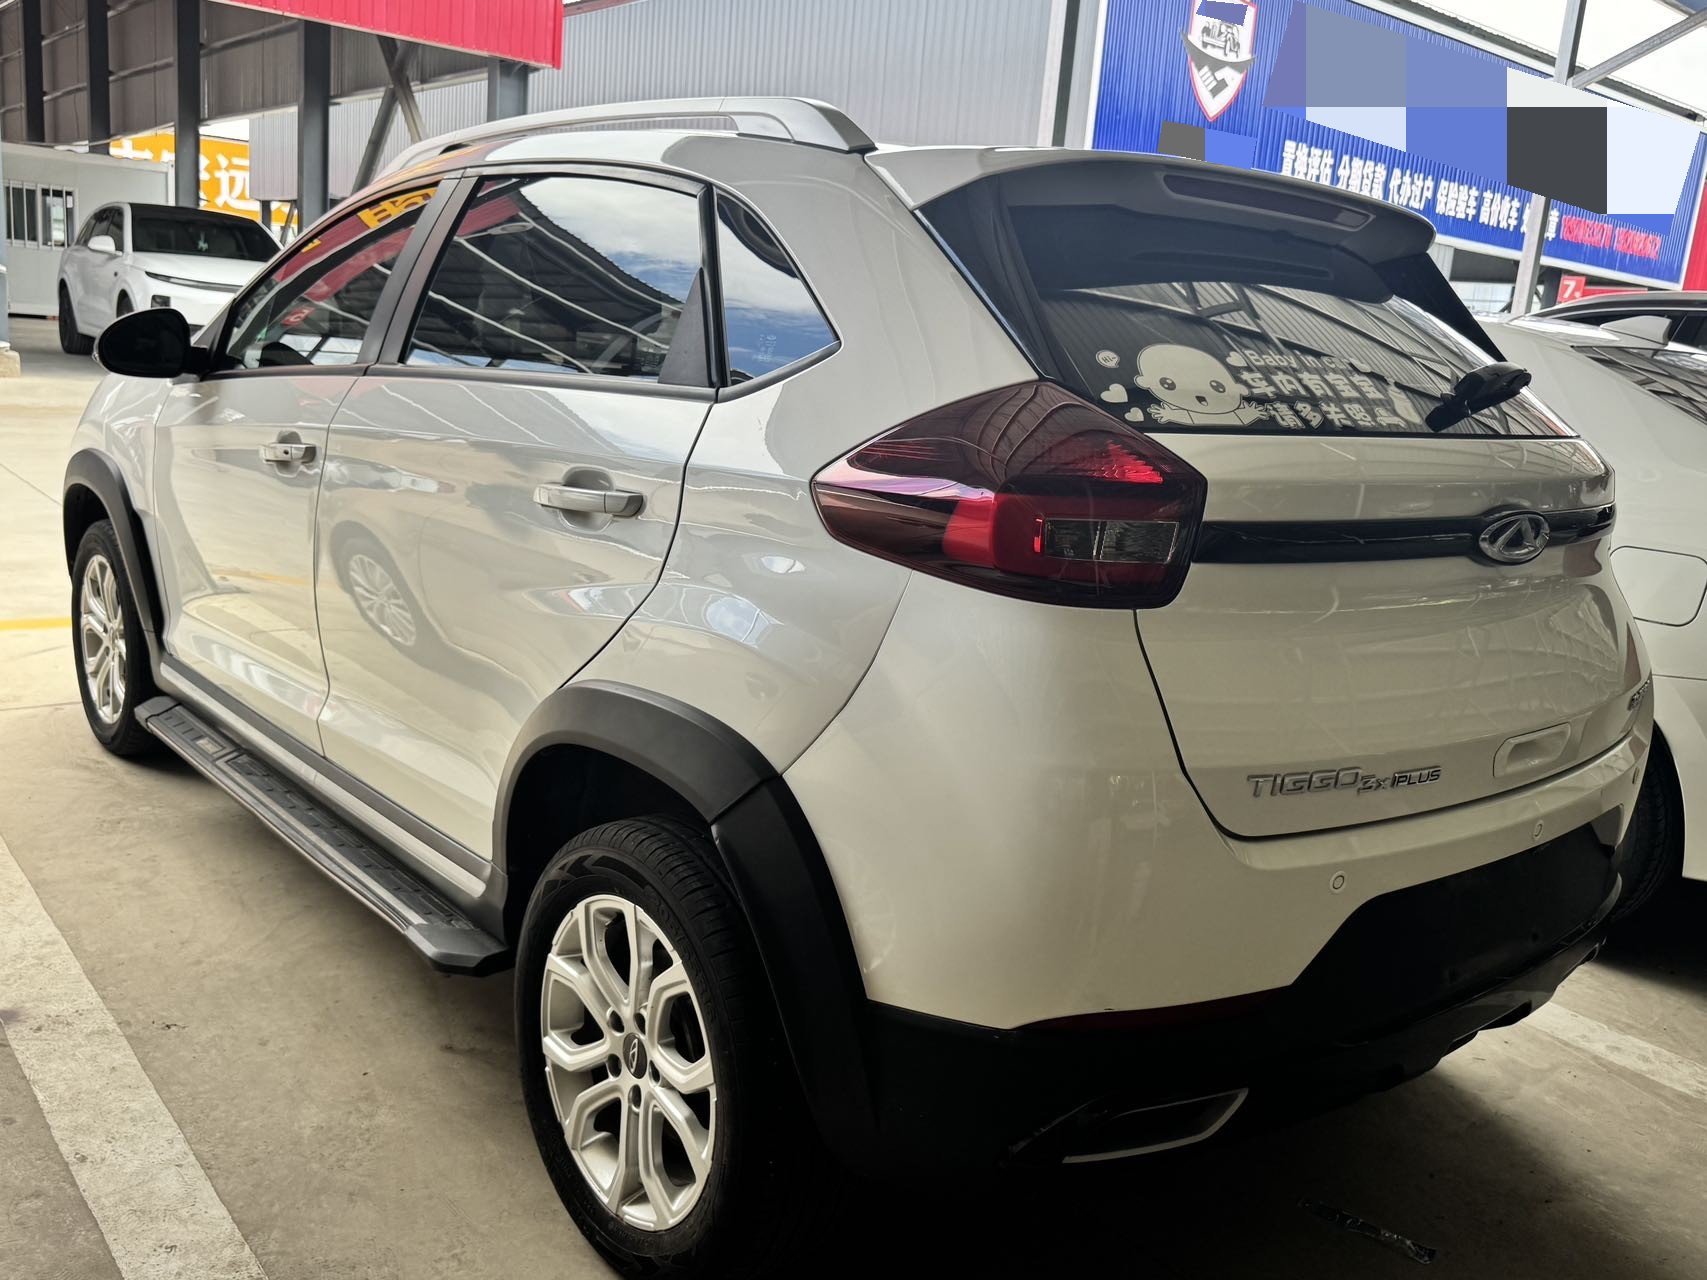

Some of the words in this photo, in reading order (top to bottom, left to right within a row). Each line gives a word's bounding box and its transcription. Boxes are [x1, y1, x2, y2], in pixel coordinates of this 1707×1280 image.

[1248, 350, 1297, 368] Baby
[1296, 350, 1323, 368] in
[1239, 371, 1385, 399] 车内有宝宝
[1266, 400, 1376, 430] 请多关照
[1247, 766, 1363, 798] TIGGO
